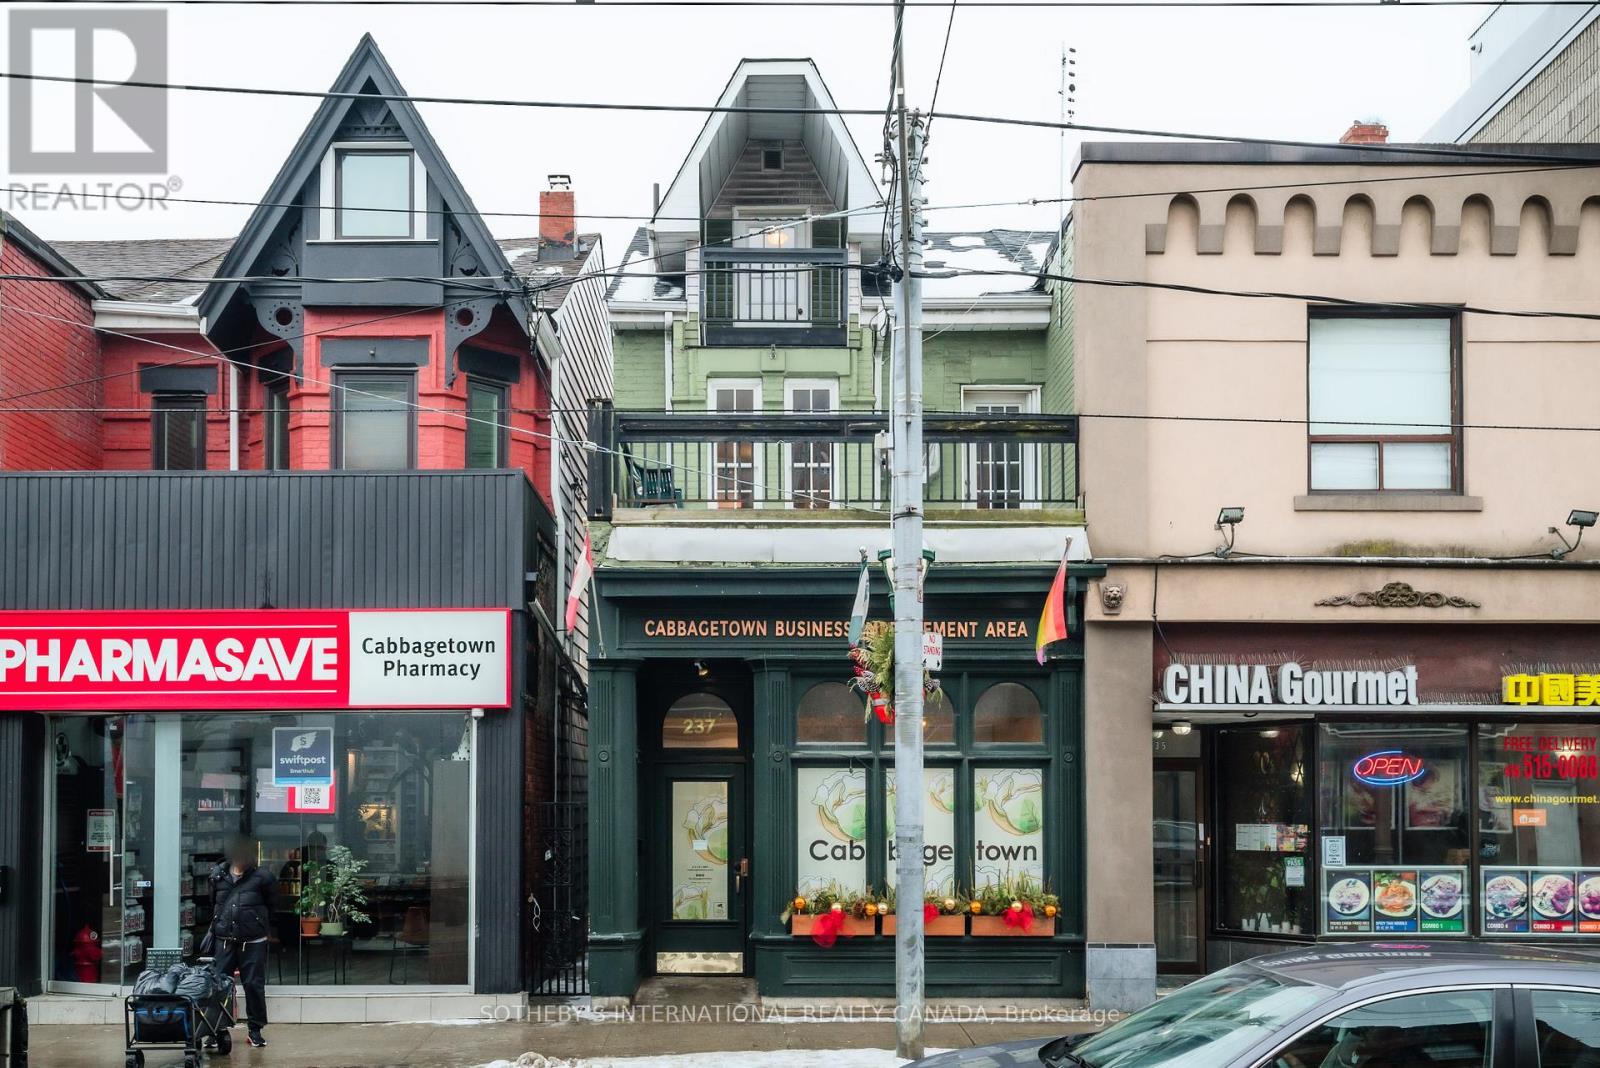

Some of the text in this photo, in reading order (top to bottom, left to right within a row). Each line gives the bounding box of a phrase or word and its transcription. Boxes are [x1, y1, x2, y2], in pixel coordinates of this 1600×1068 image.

[644, 620, 767, 637] CABBAGETOWN
[775, 621, 850, 637] BUSINESS
[984, 621, 1028, 637] AREA
[361, 636, 497, 656] Cabbagetown
[929, 635, 936, 644] NO
[923, 645, 941, 656] STANDING
[0, 637, 338, 682] PHARMASAVE
[383, 659, 481, 679] Pharmacy
[1164, 661, 1419, 706] CHINA Gourmet
[683, 719, 716, 734] 237
[1504, 735, 1597, 751] FREE DELIVERY
[279, 755, 327, 766] swiftpost
[1356, 758, 1423, 775] OPEN
[1523, 753, 1599, 779] 515-0088
[1495, 794, 1600, 805] www.chinagourmet.
